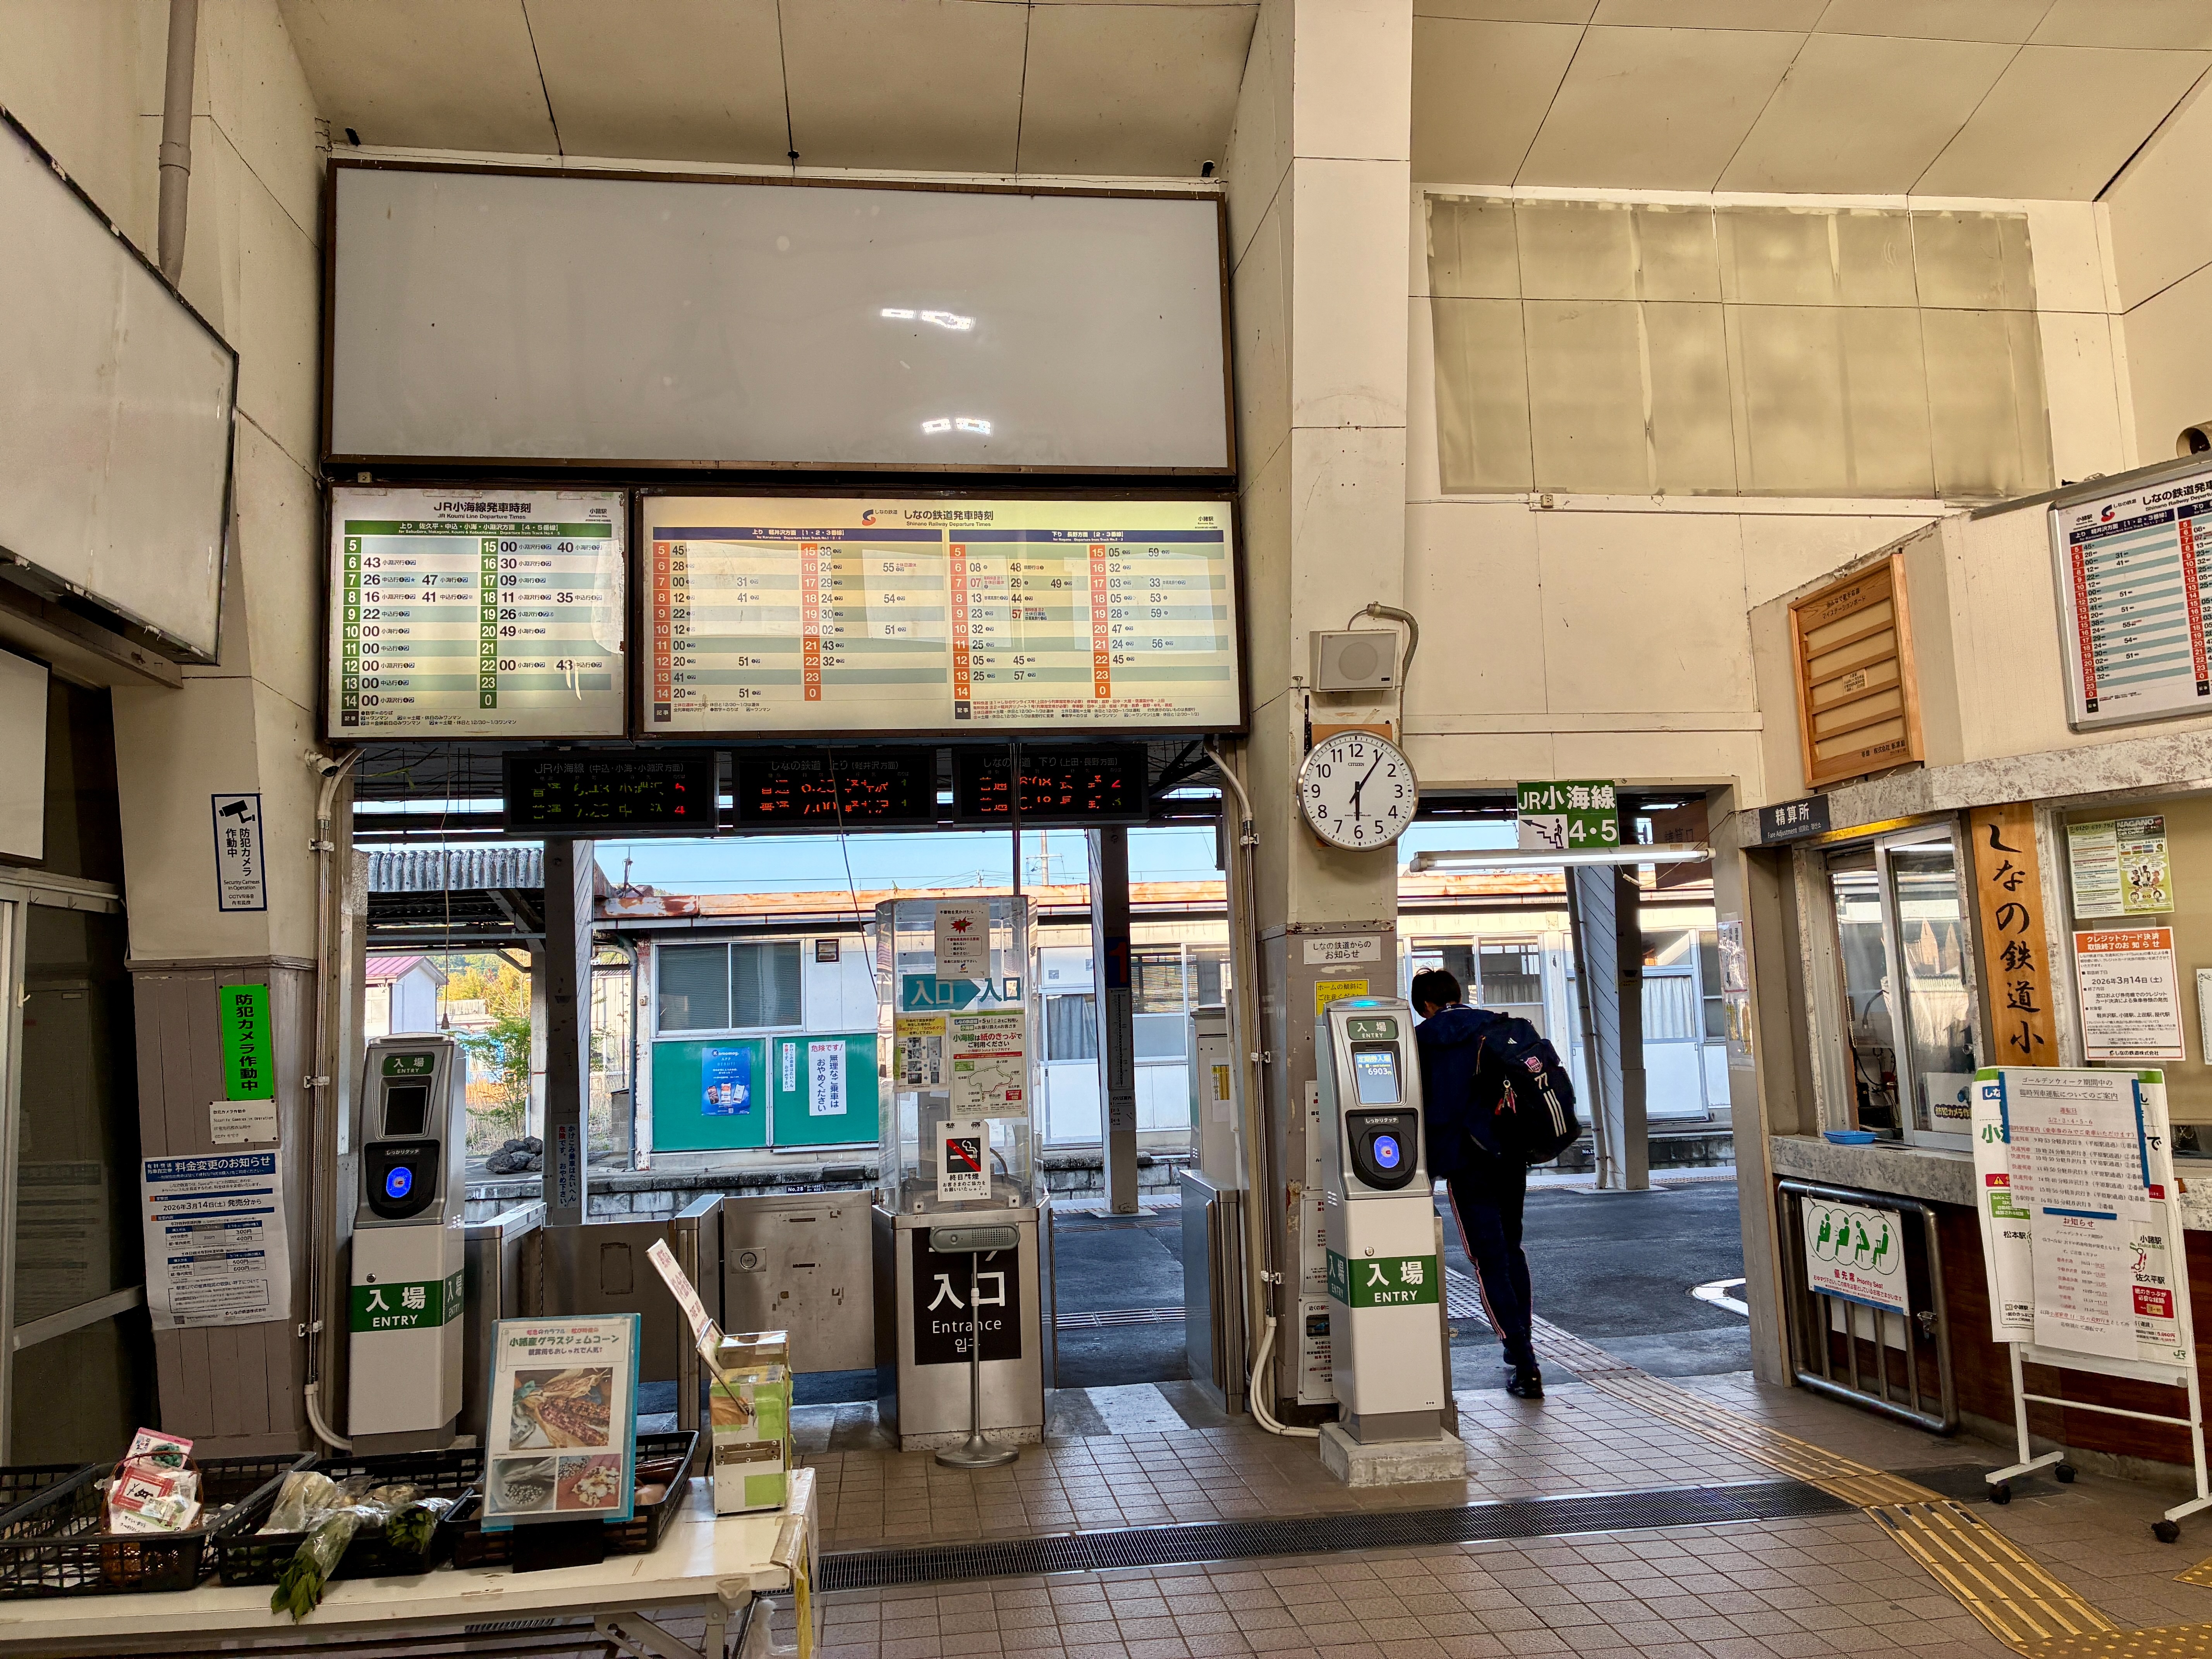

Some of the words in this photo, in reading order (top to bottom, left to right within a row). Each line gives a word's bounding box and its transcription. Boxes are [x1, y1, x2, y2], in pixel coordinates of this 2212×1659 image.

[434, 502, 531, 513] JR小海線発車時刻
[2146, 503, 2167, 512] Shinano
[2169, 498, 2189, 507] Railway
[904, 509, 994, 520] しなの鉄道発車時刻
[484, 541, 496, 552] 15
[557, 542, 573, 552] 40
[673, 546, 684, 555] 45
[820, 547, 832, 556] 38
[349, 557, 356, 568] 6
[484, 558, 496, 569] 16
[673, 562, 684, 570] 28
[804, 563, 816, 571] 16
[1109, 563, 1120, 572] 32
[364, 574, 380, 585] 26
[500, 575, 517, 586] 09
[737, 577, 747, 586] 31
[1051, 579, 1061, 588] 49
[365, 592, 379, 602] 16
[422, 592, 435, 602] 41
[737, 593, 747, 602] 41
[348, 609, 355, 620] 9
[363, 609, 380, 619] 22
[1151, 609, 1161, 617] 59
[345, 626, 358, 637] 10
[482, 626, 495, 637] 20
[823, 641, 834, 650] 43
[973, 640, 983, 649] 25
[362, 661, 379, 671] 00
[500, 660, 516, 670] 00
[556, 660, 573, 670] 43
[657, 657, 669, 665] 12
[1013, 656, 1024, 665] 45
[674, 673, 683, 682] 41
[1014, 671, 1024, 680] 57
[657, 689, 668, 697] 14
[345, 696, 357, 706] 14
[1331, 749, 1342, 762] 11
[1349, 744, 1363, 757] 12
[1373, 749, 1378, 761] 1
[771, 761, 821, 770] しなの鉄道
[830, 761, 848, 770] 上り
[984, 757, 1030, 767] しなの道
[1039, 757, 1056, 766] 下り
[535, 764, 584, 773] JR小海線
[1316, 764, 1331, 778] 10
[1388, 764, 1396, 777] 2
[1312, 784, 1320, 798] 9
[1395, 785, 1403, 798] 3
[1518, 785, 1616, 810] JR小海線
[1318, 805, 1327, 818] 8
[1388, 805, 1398, 819] 4
[1775, 802, 1809, 826] 精算所
[1334, 820, 1342, 833] 7
[1375, 821, 1383, 833] 5
[2117, 819, 2154, 827] NAGANO
[1354, 825, 1363, 838] 6
[1569, 819, 1617, 842] 4・5
[1776, 828, 1797, 838] Adjustment
[225, 828, 237, 858] 作動中
[239, 828, 251, 876] 防犯カメラ
[1988, 824, 2044, 1053] しなの鉄道小
[2087, 933, 2159, 943] クレジットカード決済
[1313, 941, 1371, 950] しなの鉄道からの
[1325, 950, 1360, 959] お知らせ
[911, 981, 953, 1005] 入口
[979, 977, 1020, 1002] 入口
[1357, 1022, 1387, 1032] 入場
[235, 994, 258, 1091] 防犯カメラ作動中
[953, 1033, 1022, 1042] 小海線は紙のきっぷで
[393, 1057, 424, 1068] 入場
[817, 1059, 826, 1112] おやめください
[830, 1055, 840, 1108] 無理なご乗車は
[1534, 1072, 1548, 1090] 77
[2022, 1077, 2113, 1086] ゴールデンウィーク期間中の
[2147, 1136, 2162, 1151] で
[175, 1156, 270, 1172] 料金変更のお知らせ
[228, 1199, 262, 1207] 発売分から
[2063, 1218, 2095, 1228] お知らせ
[2004, 1230, 2026, 1239] 松本駅
[1329, 1254, 1345, 1284] 入場
[1367, 1261, 1424, 1287] 入場
[2135, 1274, 2165, 1284] 佐久平駅
[927, 1271, 1005, 1311] 入口
[1332, 1283, 1343, 1299] ENTRY
[1374, 1290, 1418, 1303] ENTRY
[366, 1286, 426, 1313] 入場
[373, 1314, 418, 1328] ENTRY
